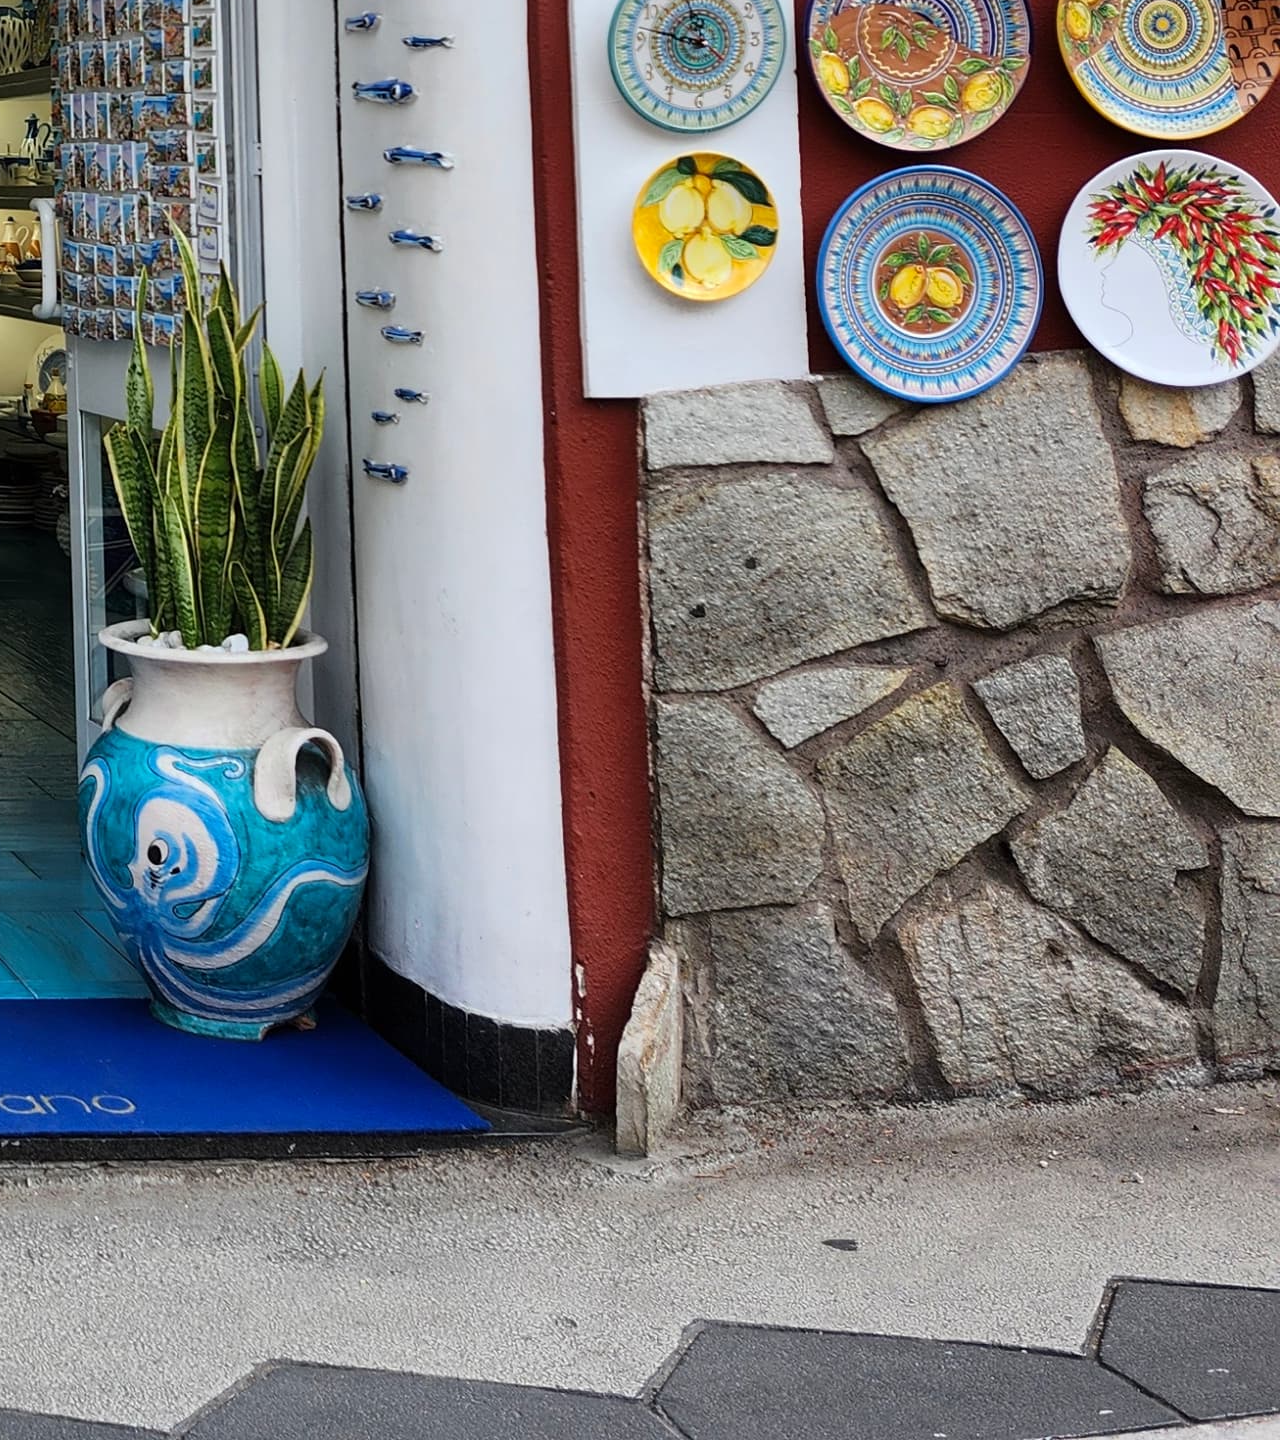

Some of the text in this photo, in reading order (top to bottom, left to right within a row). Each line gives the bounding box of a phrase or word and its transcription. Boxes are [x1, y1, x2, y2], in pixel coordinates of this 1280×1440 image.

[743, 2, 754, 19] 2
[636, 31, 646, 51] 9
[750, 31, 760, 47] 3
[744, 62, 755, 76] 4
[665, 85, 674, 102] 7
[724, 84, 733, 99] 5
[694, 92, 704, 109] 6
